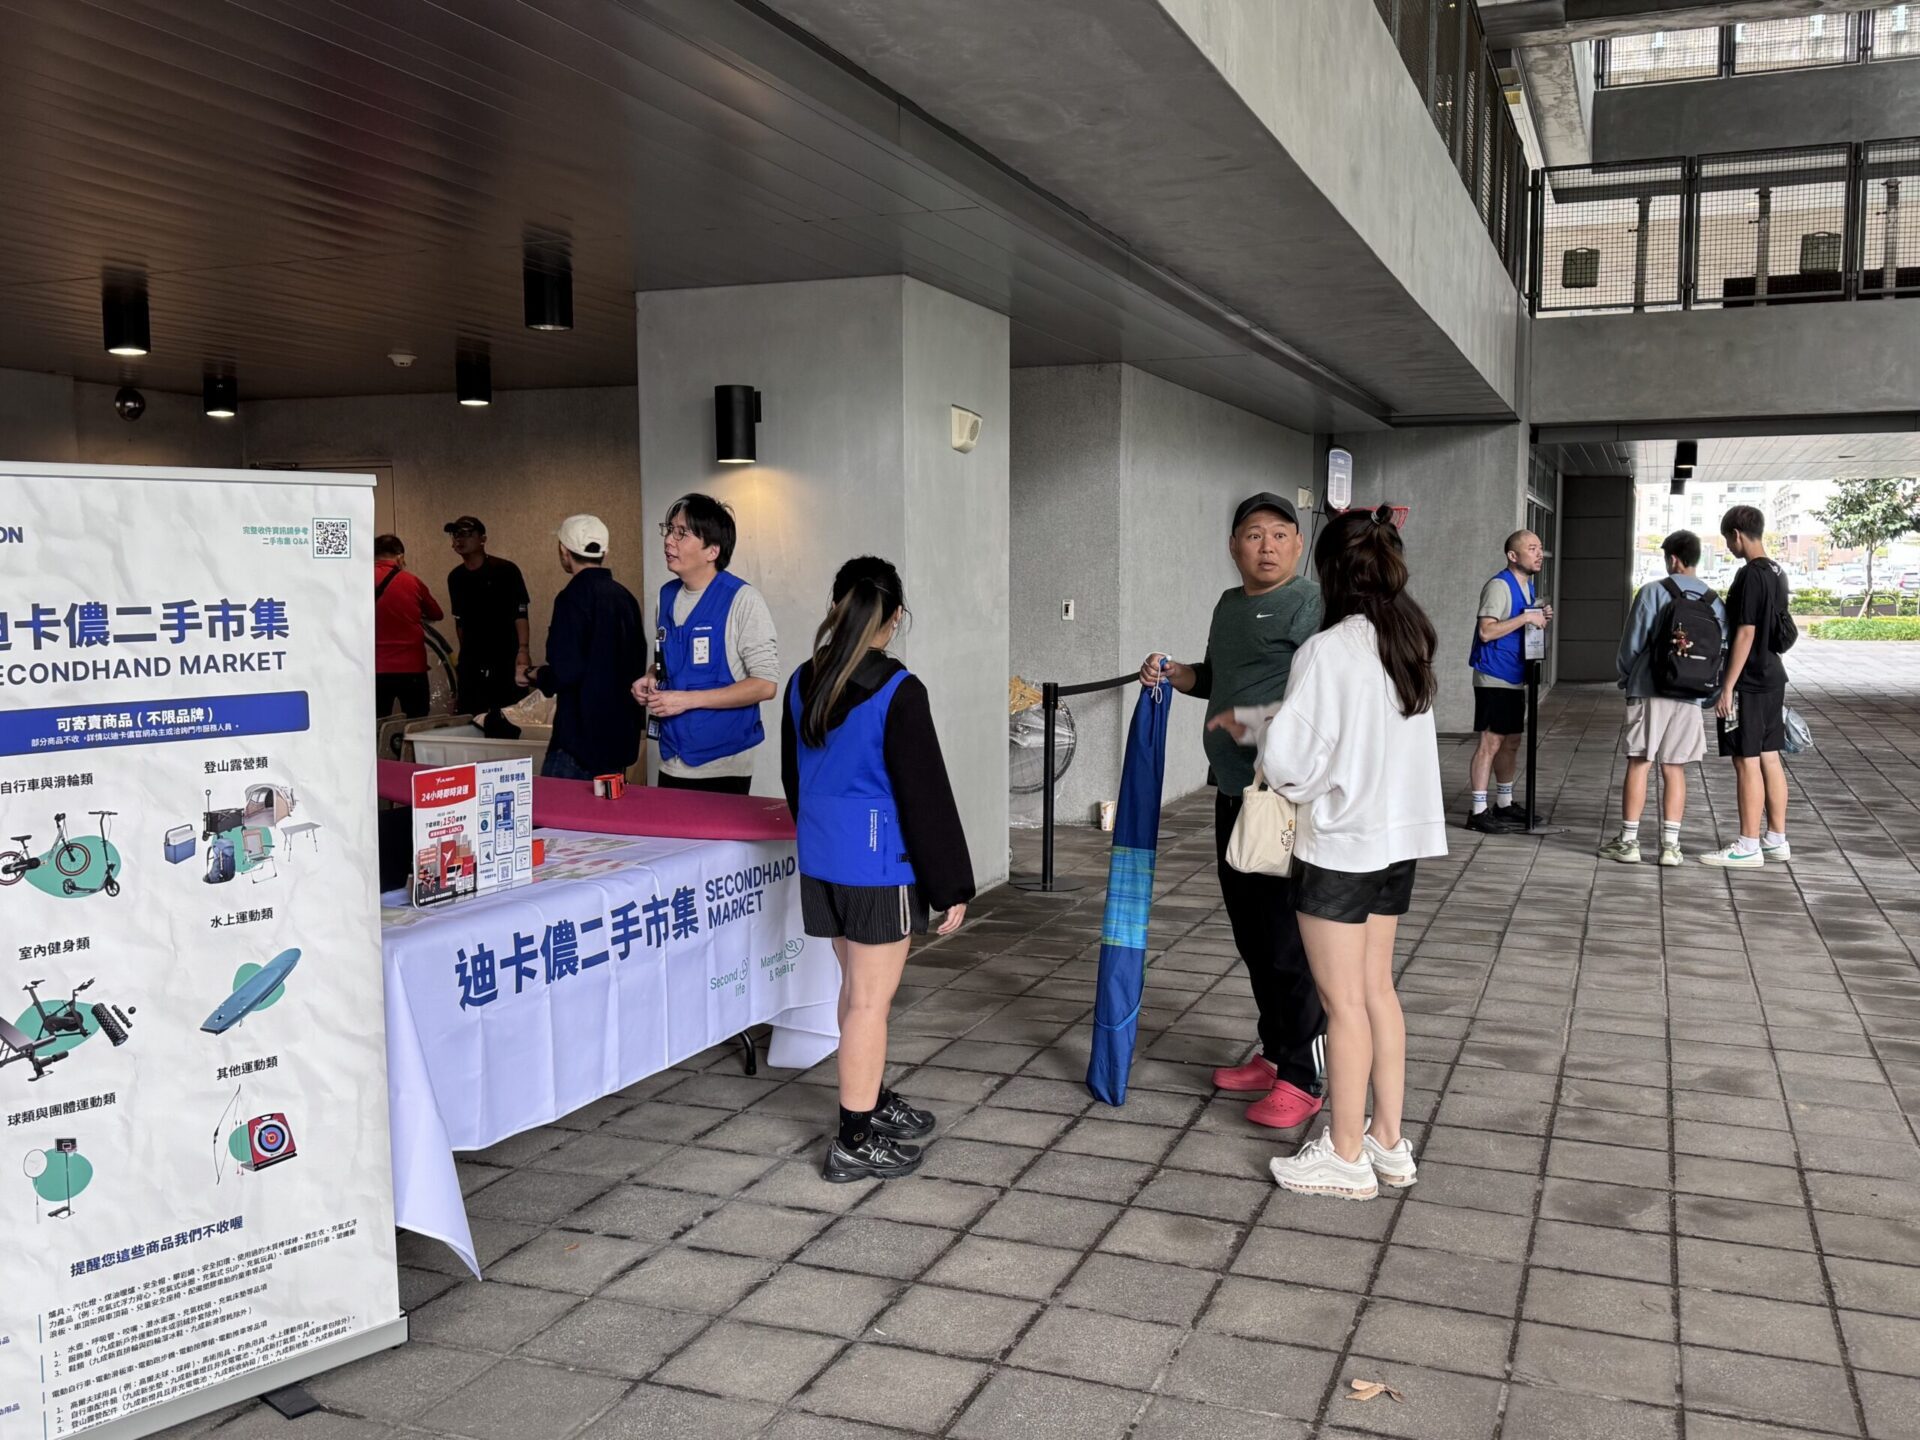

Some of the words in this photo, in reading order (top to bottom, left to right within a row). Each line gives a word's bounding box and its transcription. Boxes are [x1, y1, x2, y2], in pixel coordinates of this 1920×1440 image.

[263, 537, 291, 545] 二手市集
[293, 537, 309, 545] Q&A
[0, 597, 290, 651] 卡儂二手市集
[180, 651, 287, 676] MARKET
[204, 756, 269, 774] 登山露營類
[0, 772, 94, 795] 自行車與滑輪類
[210, 907, 274, 929] 水上運動類
[707, 890, 764, 930] MARKET
[18, 936, 91, 961] 室內健身類
[455, 886, 700, 1012] 迪卡儂二手市集
[760, 949, 784, 969] Maintai
[710, 968, 738, 990] Second
[735, 983, 746, 997] life
[216, 1055, 279, 1081] 其他運動類
[7, 1091, 117, 1127] 球類與團體運動類
[70, 1215, 244, 1277] 提醒您這些商品我們不收喔
